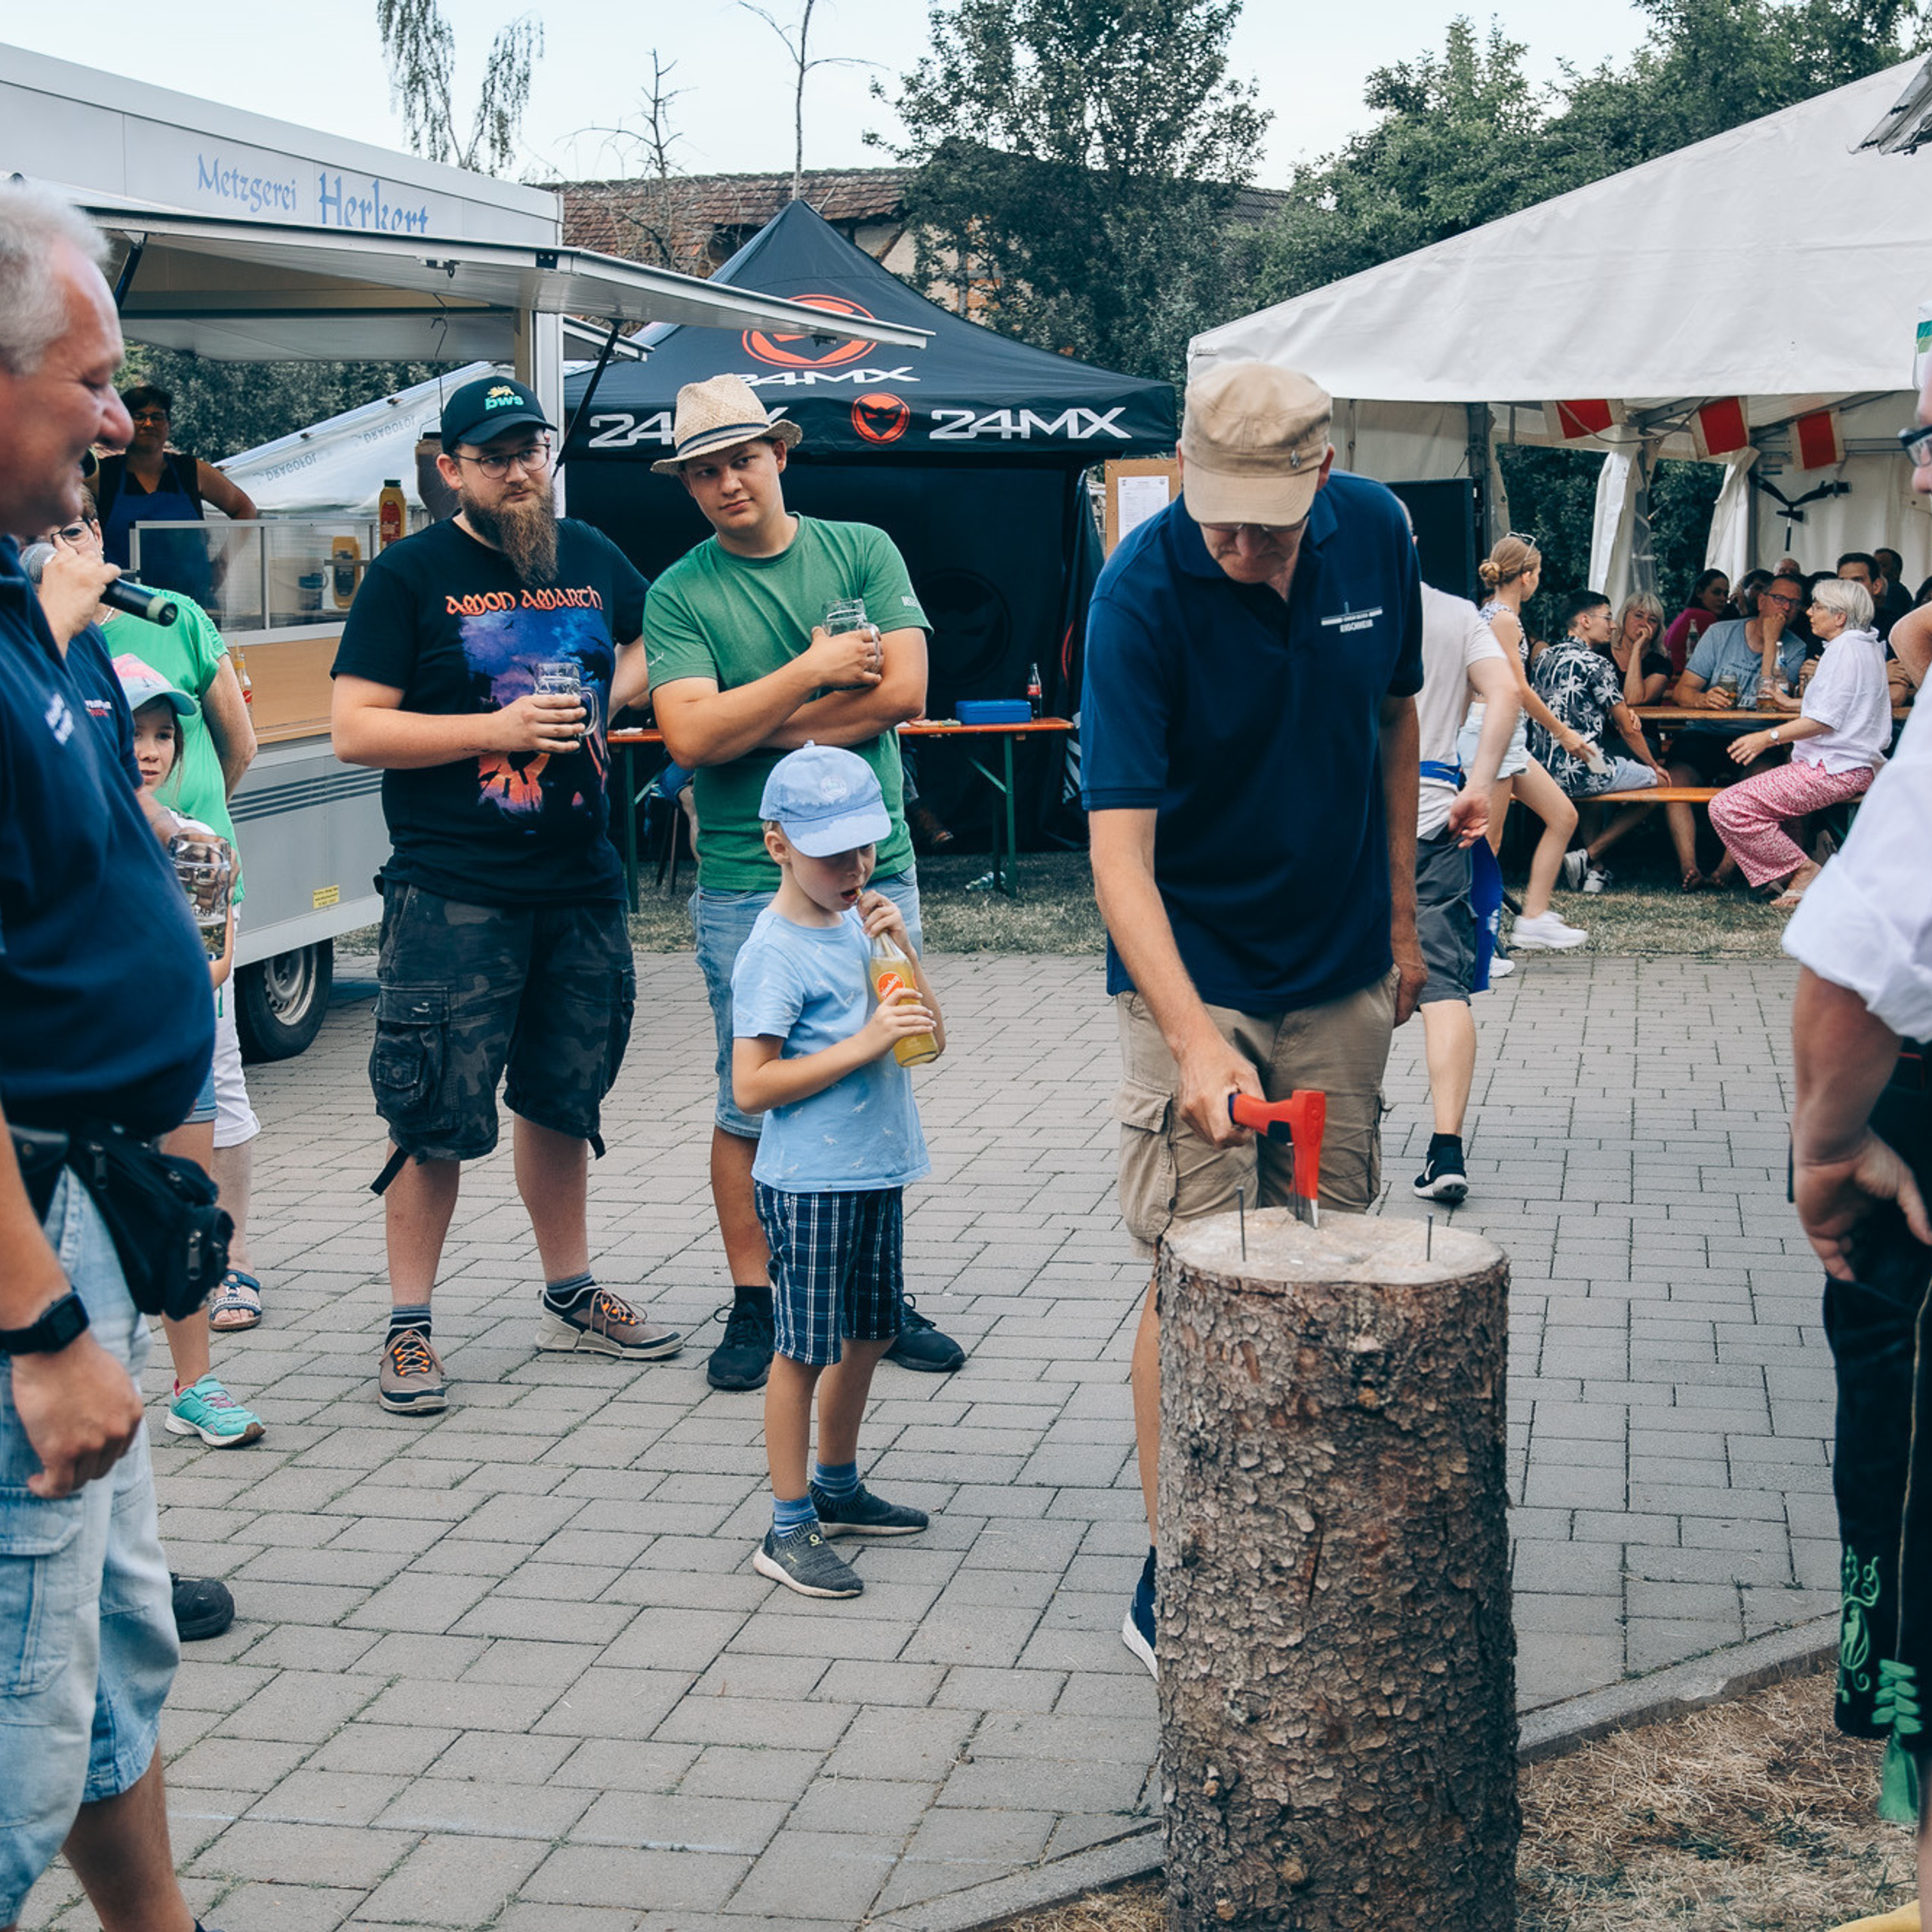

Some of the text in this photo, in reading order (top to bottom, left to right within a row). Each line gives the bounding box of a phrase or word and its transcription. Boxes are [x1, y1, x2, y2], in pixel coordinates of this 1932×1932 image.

[197, 152, 429, 234] Metzgerei Herkort
[929, 406, 1133, 440] 24MX
